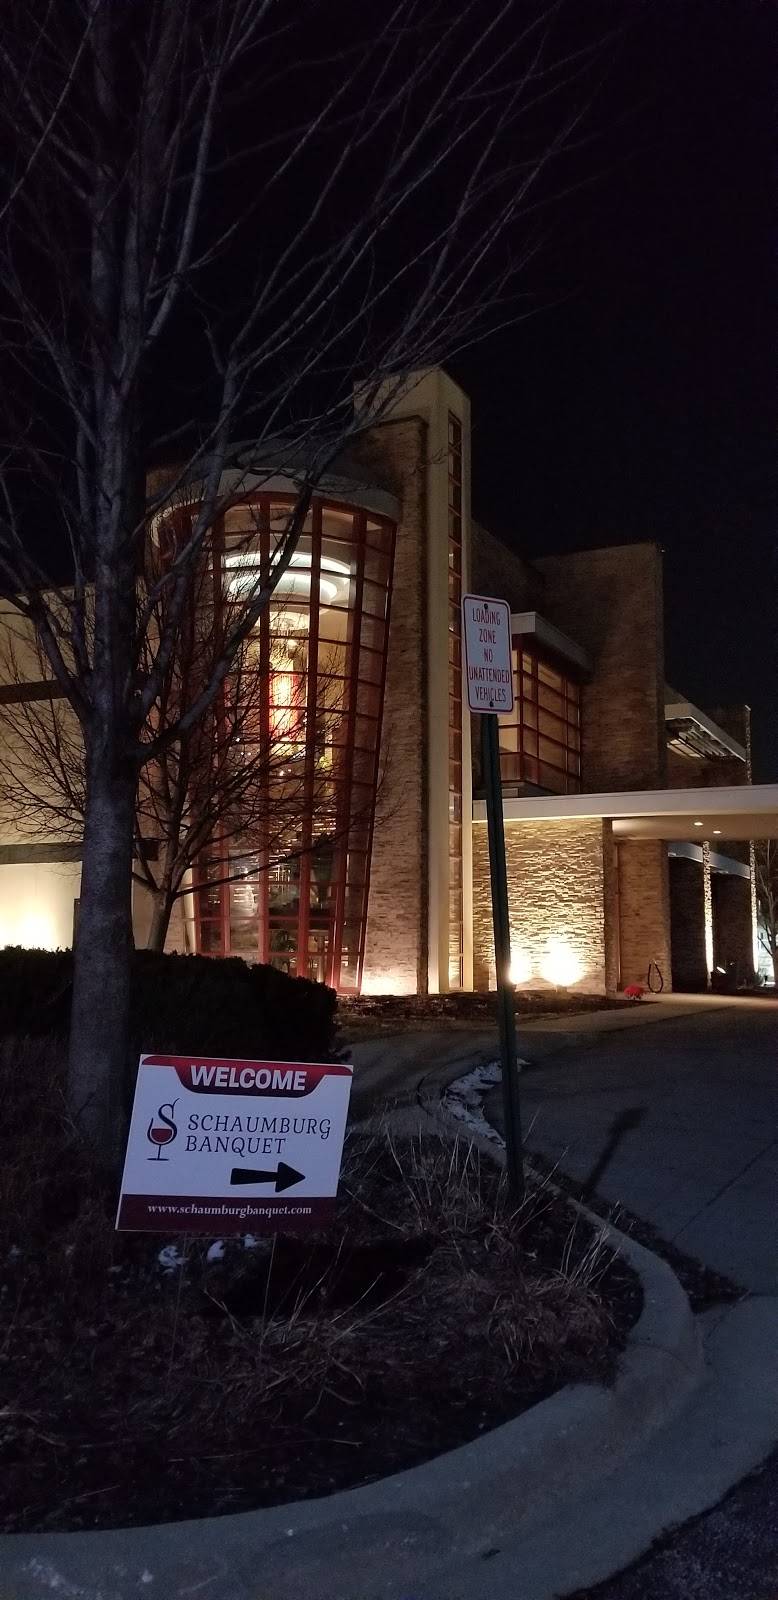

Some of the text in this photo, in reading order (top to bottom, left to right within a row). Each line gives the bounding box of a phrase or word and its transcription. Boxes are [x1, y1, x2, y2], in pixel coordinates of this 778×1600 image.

[472, 607, 501, 626] LOADING
[479, 628, 497, 645] ZONE
[484, 648, 493, 662] NO
[469, 666, 509, 683] UNATTENDED
[475, 686, 506, 702] VEHICLES
[190, 1064, 307, 1091] WELCOME
[187, 1113, 332, 1141] SCHAUMBURG
[184, 1135, 287, 1158] BANQUET
[147, 1203, 313, 1219] www.schaumburgbanquet.com
